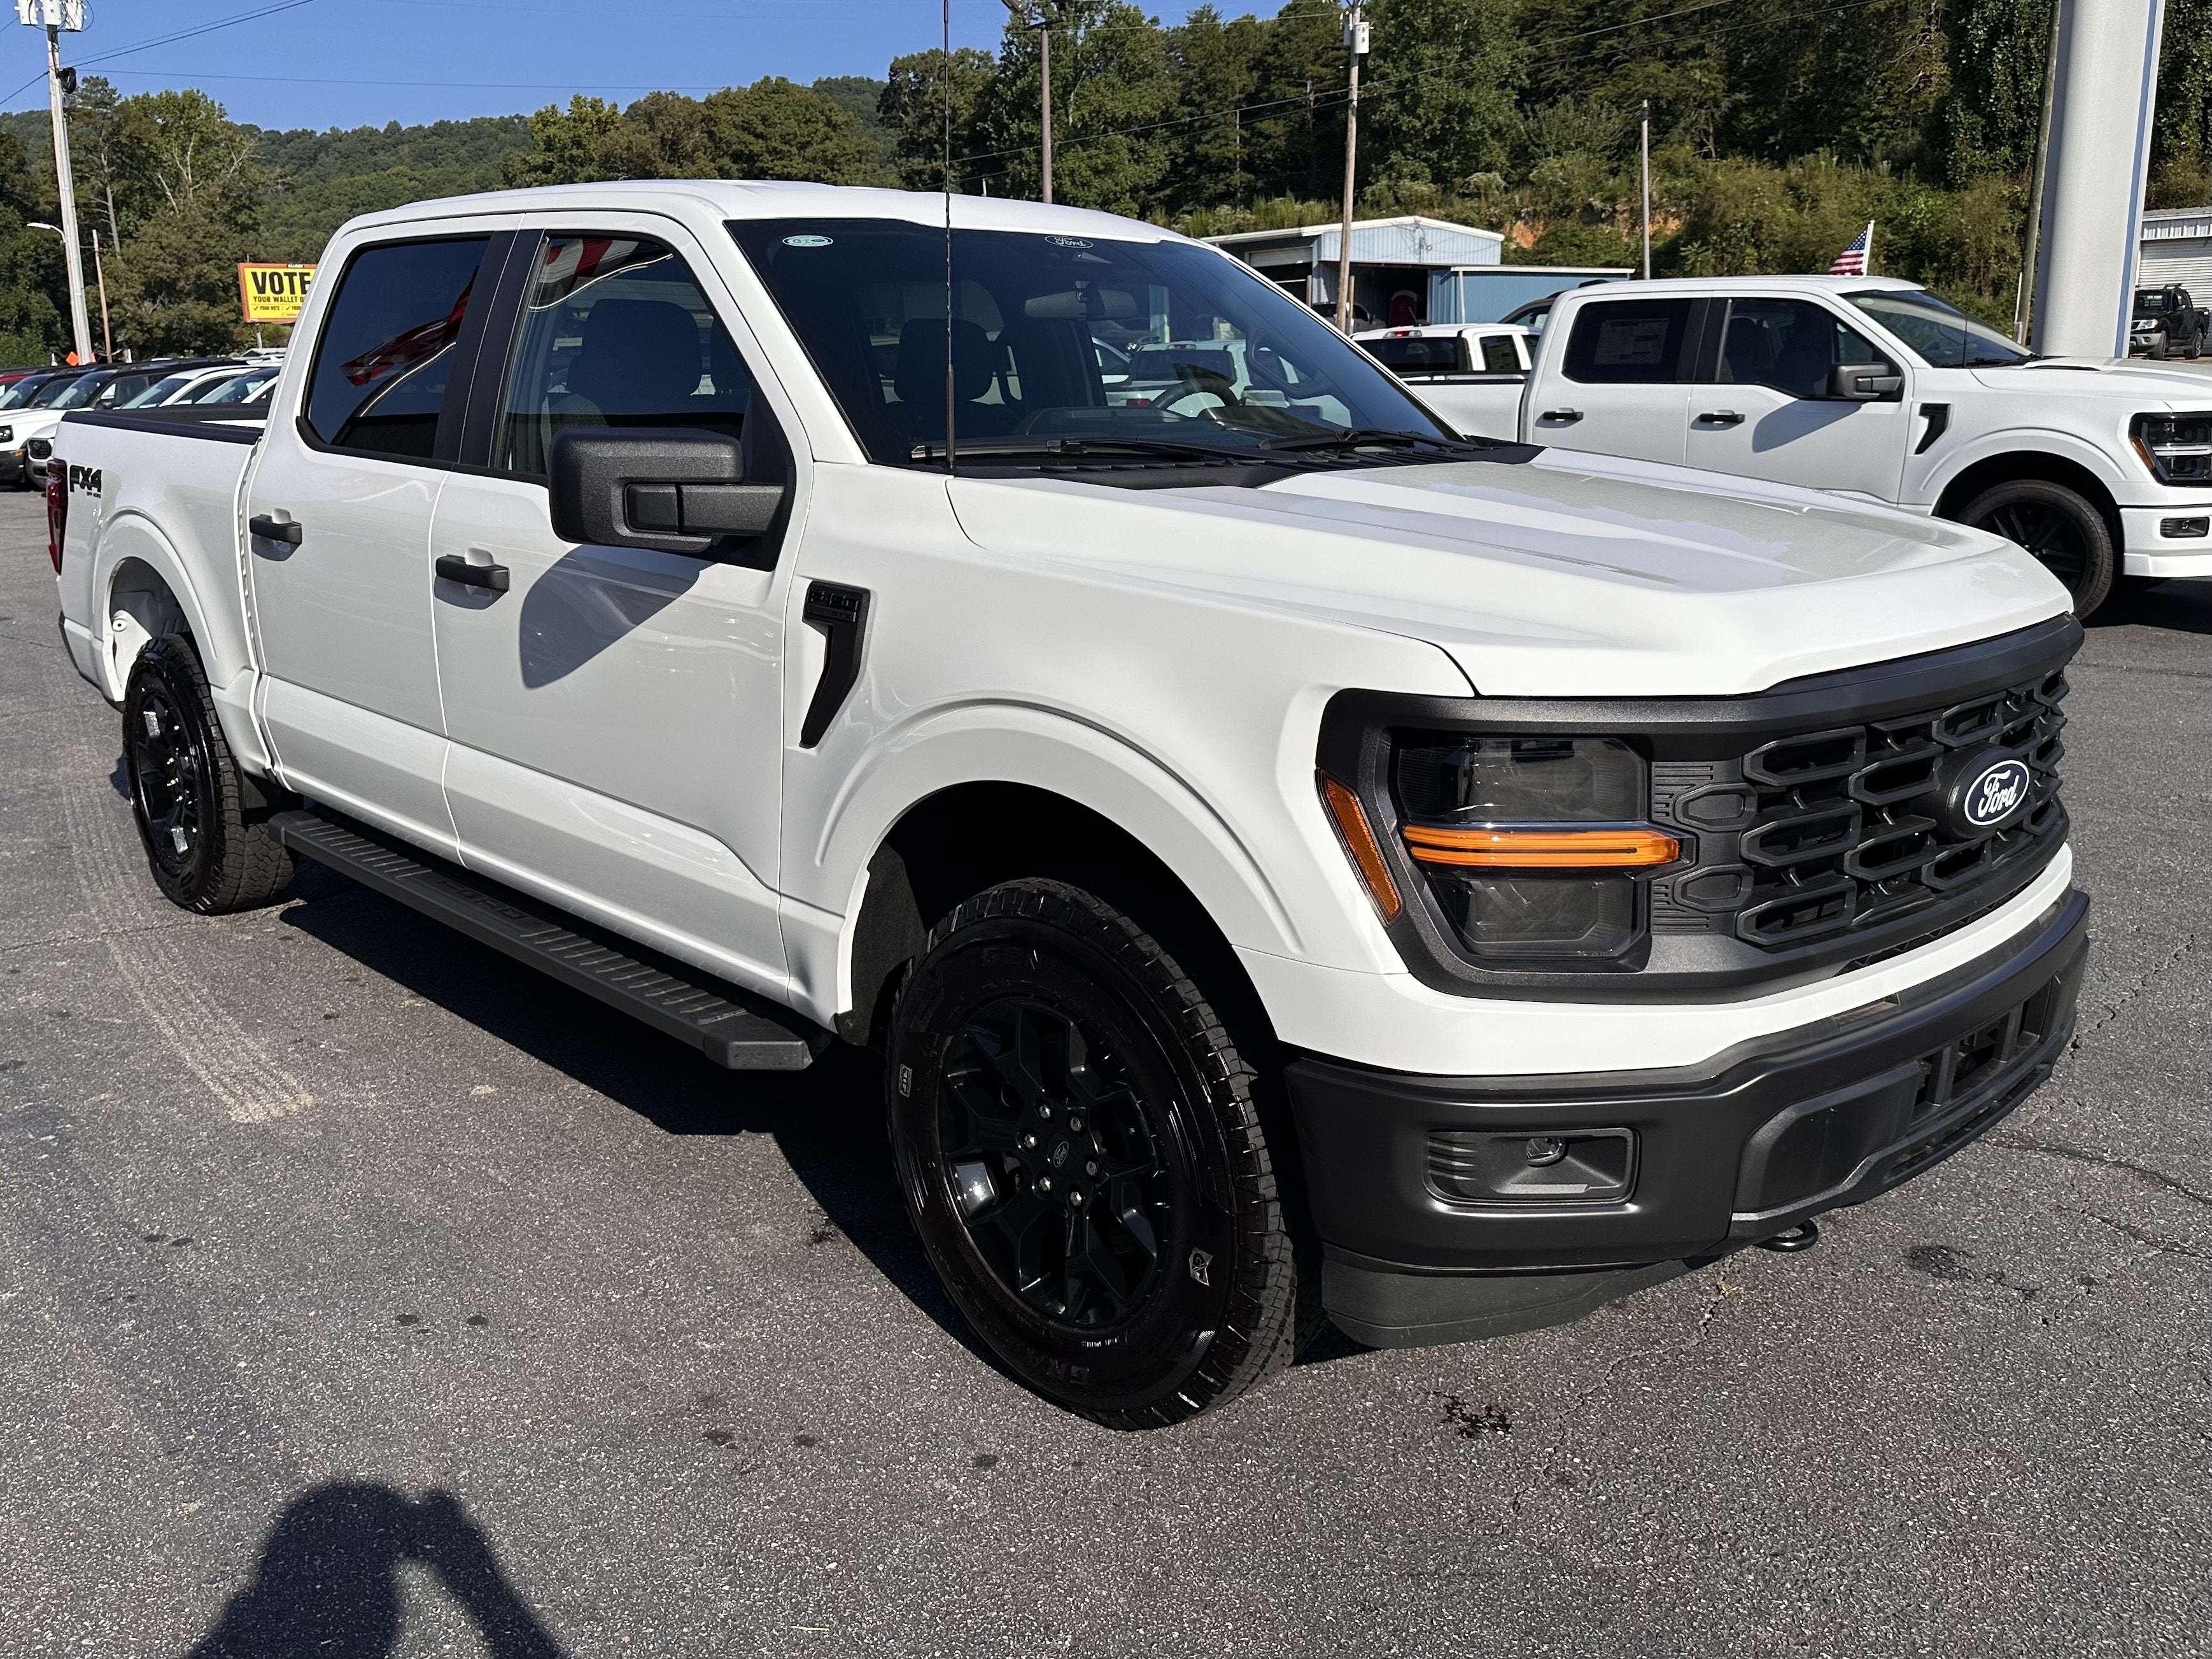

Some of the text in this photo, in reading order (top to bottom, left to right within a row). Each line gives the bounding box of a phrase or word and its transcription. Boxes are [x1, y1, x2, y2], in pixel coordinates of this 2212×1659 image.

[1054, 236, 1086, 247] Ford
[251, 272, 311, 295] VOTE
[70, 465, 102, 493] FX4
[1977, 769, 2020, 818] Ford
